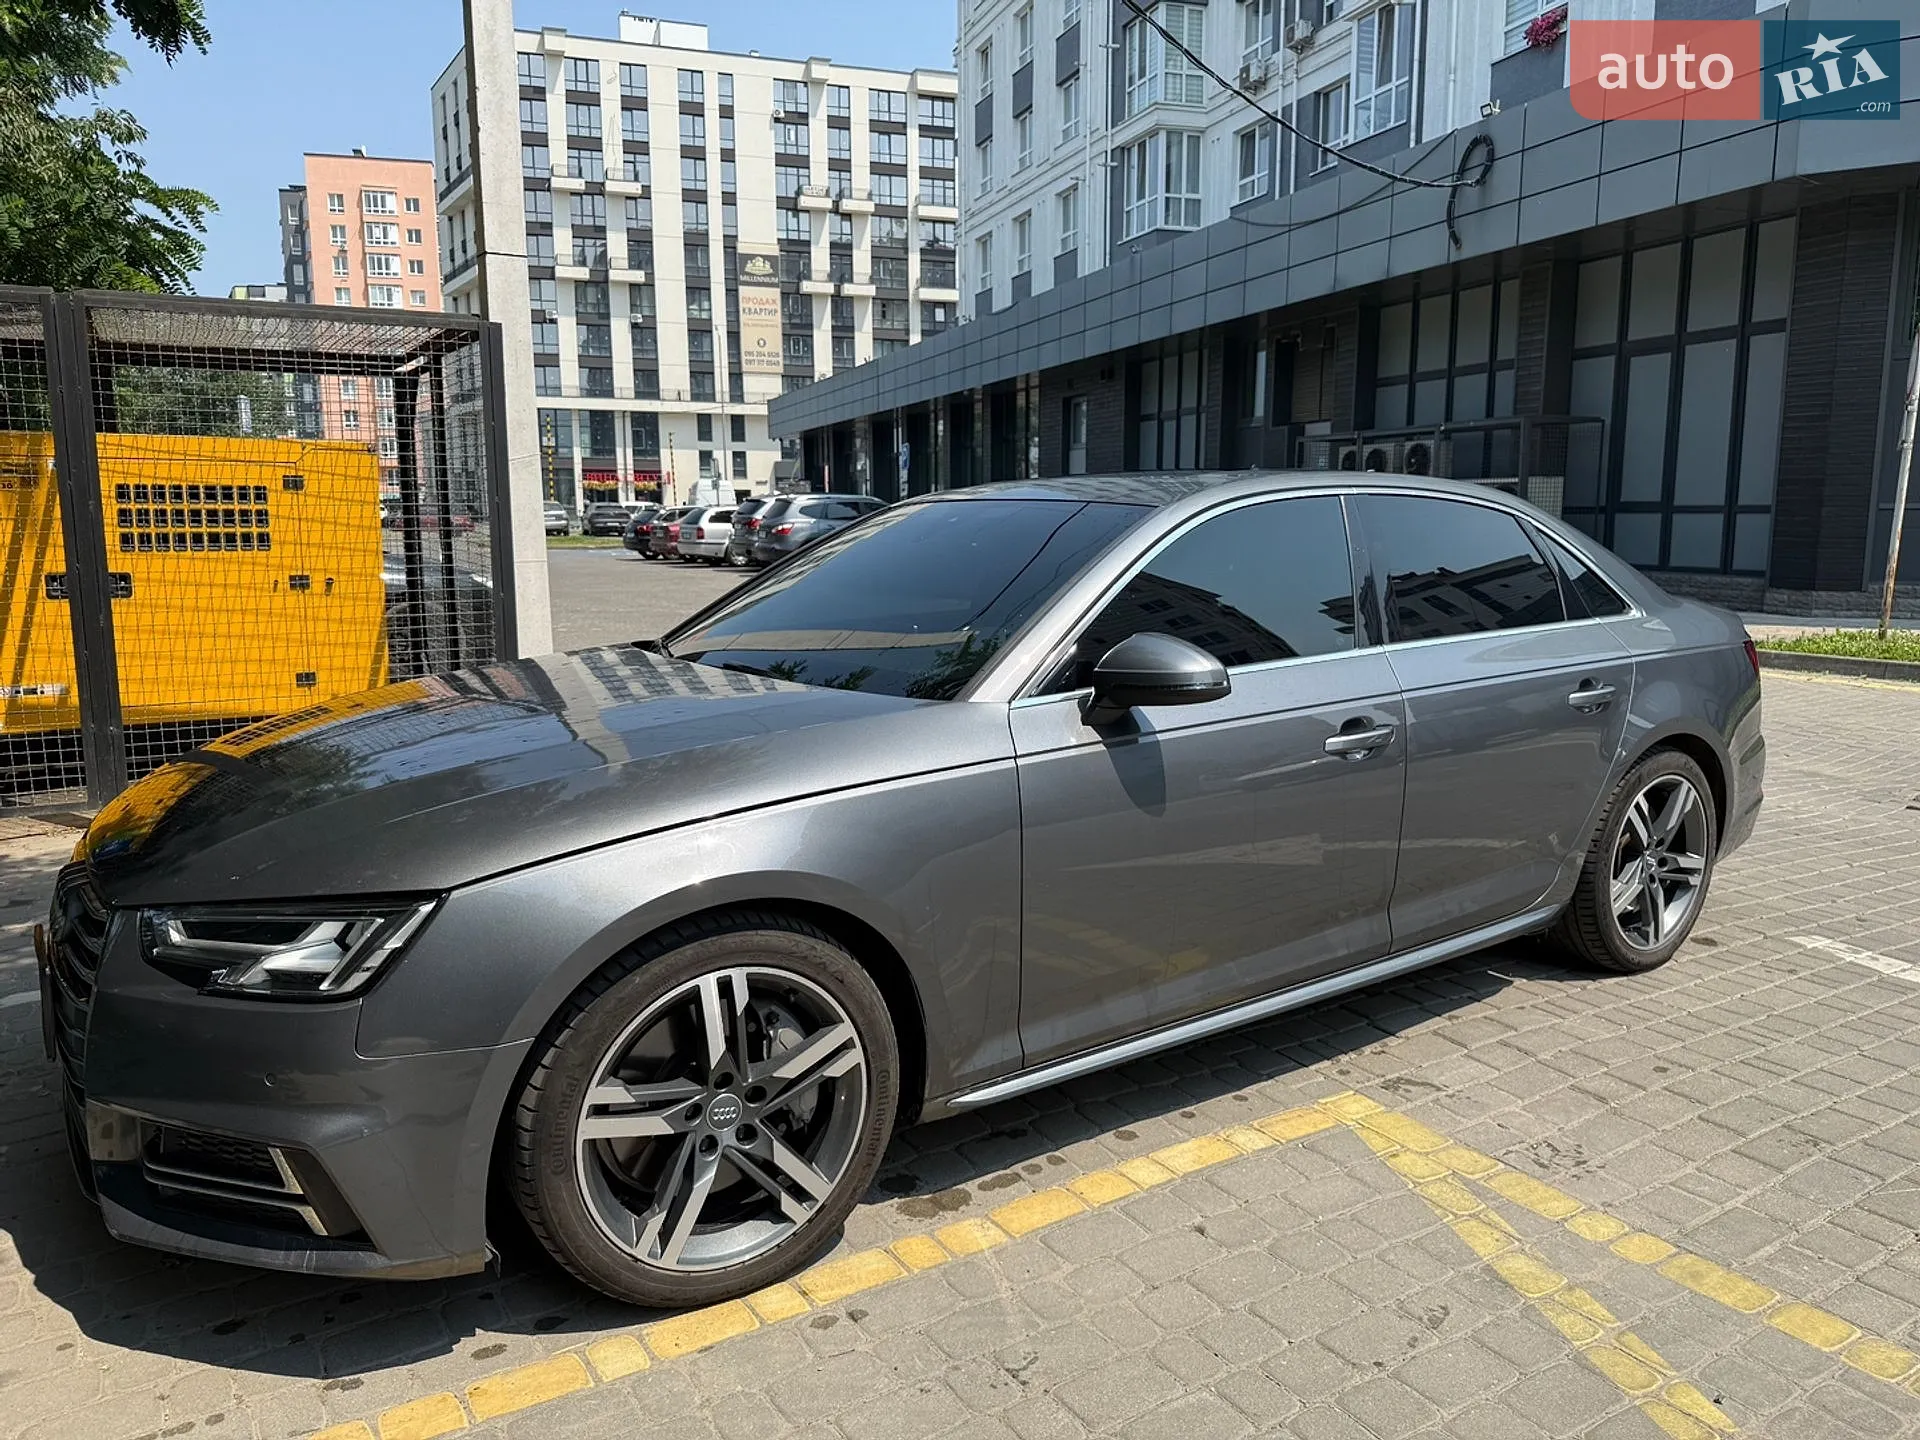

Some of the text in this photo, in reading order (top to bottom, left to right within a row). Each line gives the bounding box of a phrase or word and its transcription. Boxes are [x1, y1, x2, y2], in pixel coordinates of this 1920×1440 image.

[739, 275, 779, 283] MILLENNIUM
[741, 296, 777, 306] ПРОДАЖ
[742, 306, 778, 317] КВАРТИР
[866, 1070, 891, 1158] Continental
[550, 1074, 581, 1176] Continental
